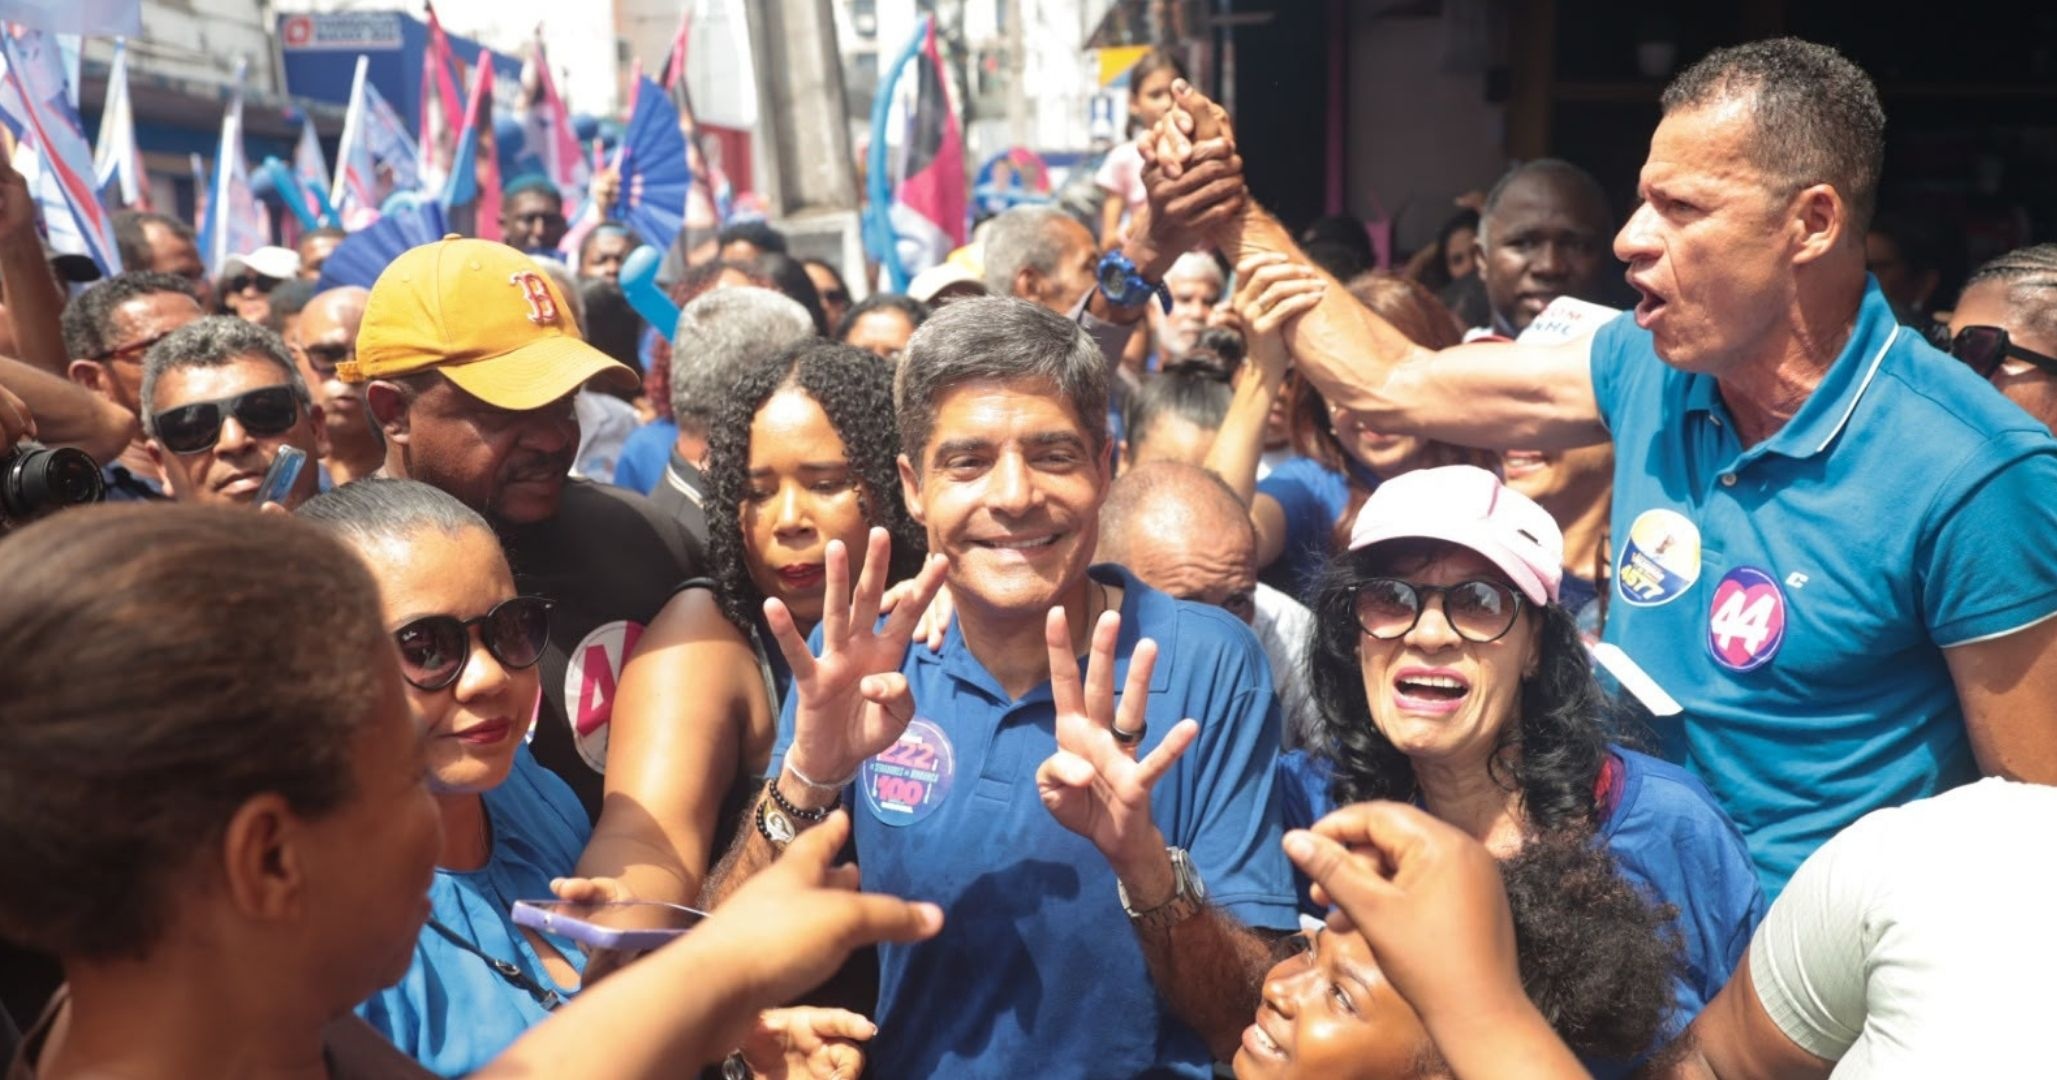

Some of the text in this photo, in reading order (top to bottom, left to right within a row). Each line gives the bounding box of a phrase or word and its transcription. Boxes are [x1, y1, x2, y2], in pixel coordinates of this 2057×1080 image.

[509, 271, 558, 322] B
[1620, 564, 1665, 600] 4577
[1710, 589, 1777, 657] 44
[877, 774, 924, 806] 100
